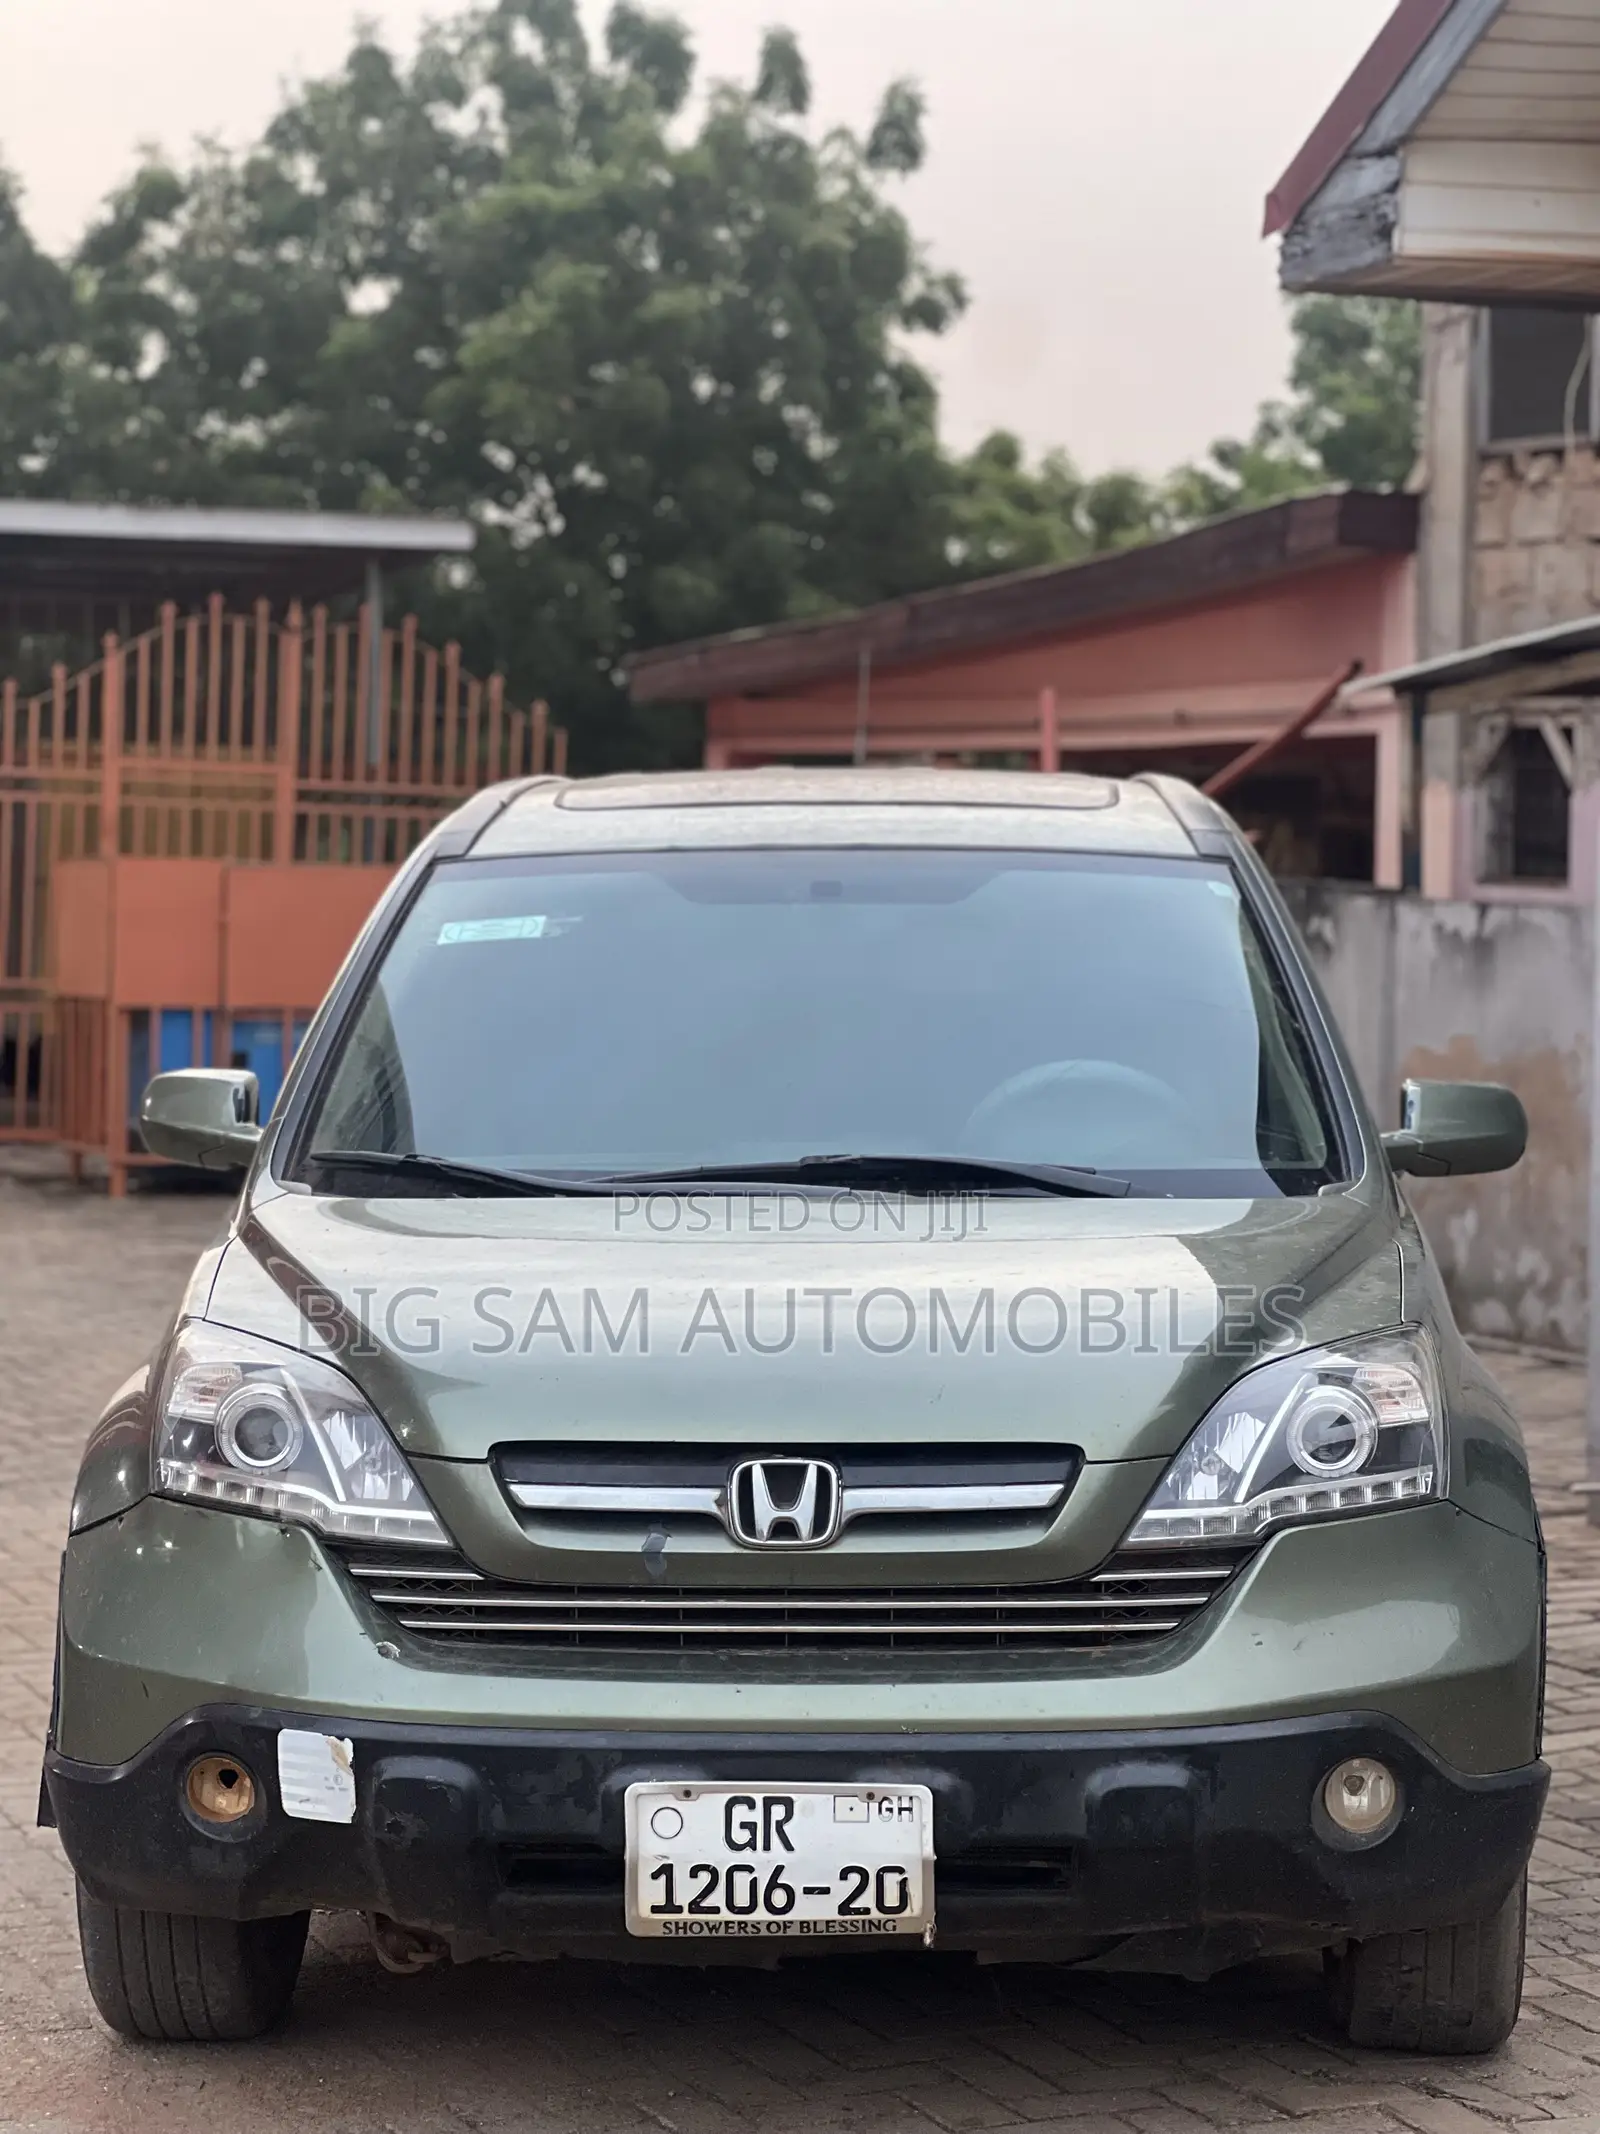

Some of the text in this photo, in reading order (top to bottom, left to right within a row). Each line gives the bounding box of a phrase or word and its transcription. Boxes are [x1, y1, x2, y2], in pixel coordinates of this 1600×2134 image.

[723, 1795, 795, 1852] GR
[877, 1796, 914, 1822] GH
[650, 1863, 910, 1916] 1206-20
[662, 1918, 898, 1936] SHOWERS OF BLESSING
